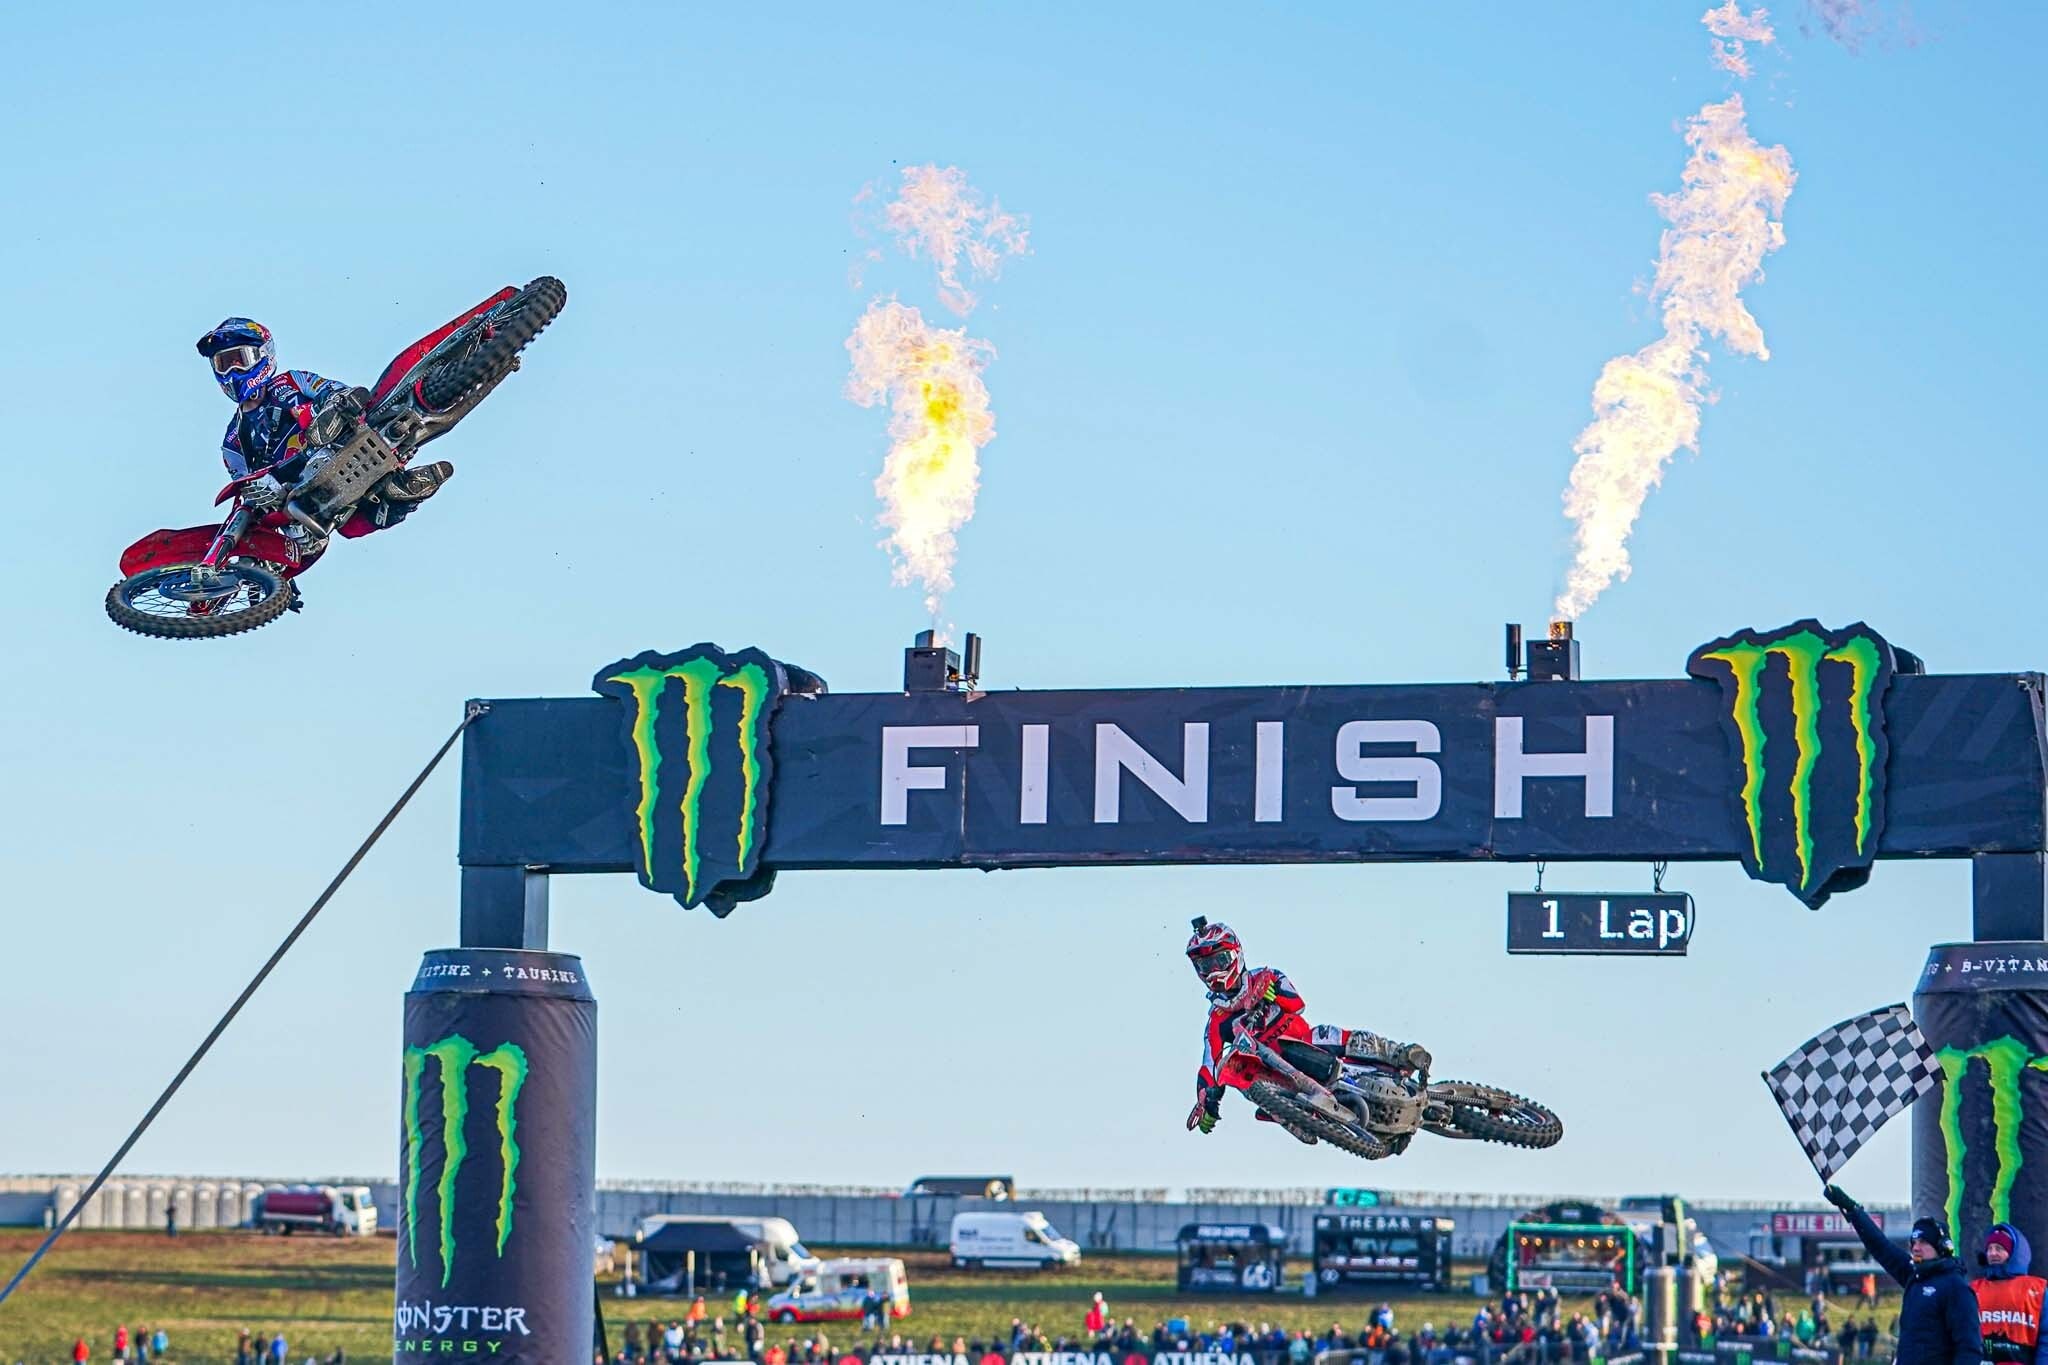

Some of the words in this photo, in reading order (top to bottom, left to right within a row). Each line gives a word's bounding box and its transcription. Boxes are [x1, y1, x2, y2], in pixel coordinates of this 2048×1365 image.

[881, 715, 1614, 825] FINISH
[1542, 900, 1564, 938] 1
[1599, 900, 1685, 949] Lap
[503, 963, 578, 984] TAURINE
[396, 1300, 531, 1336] ONSTER
